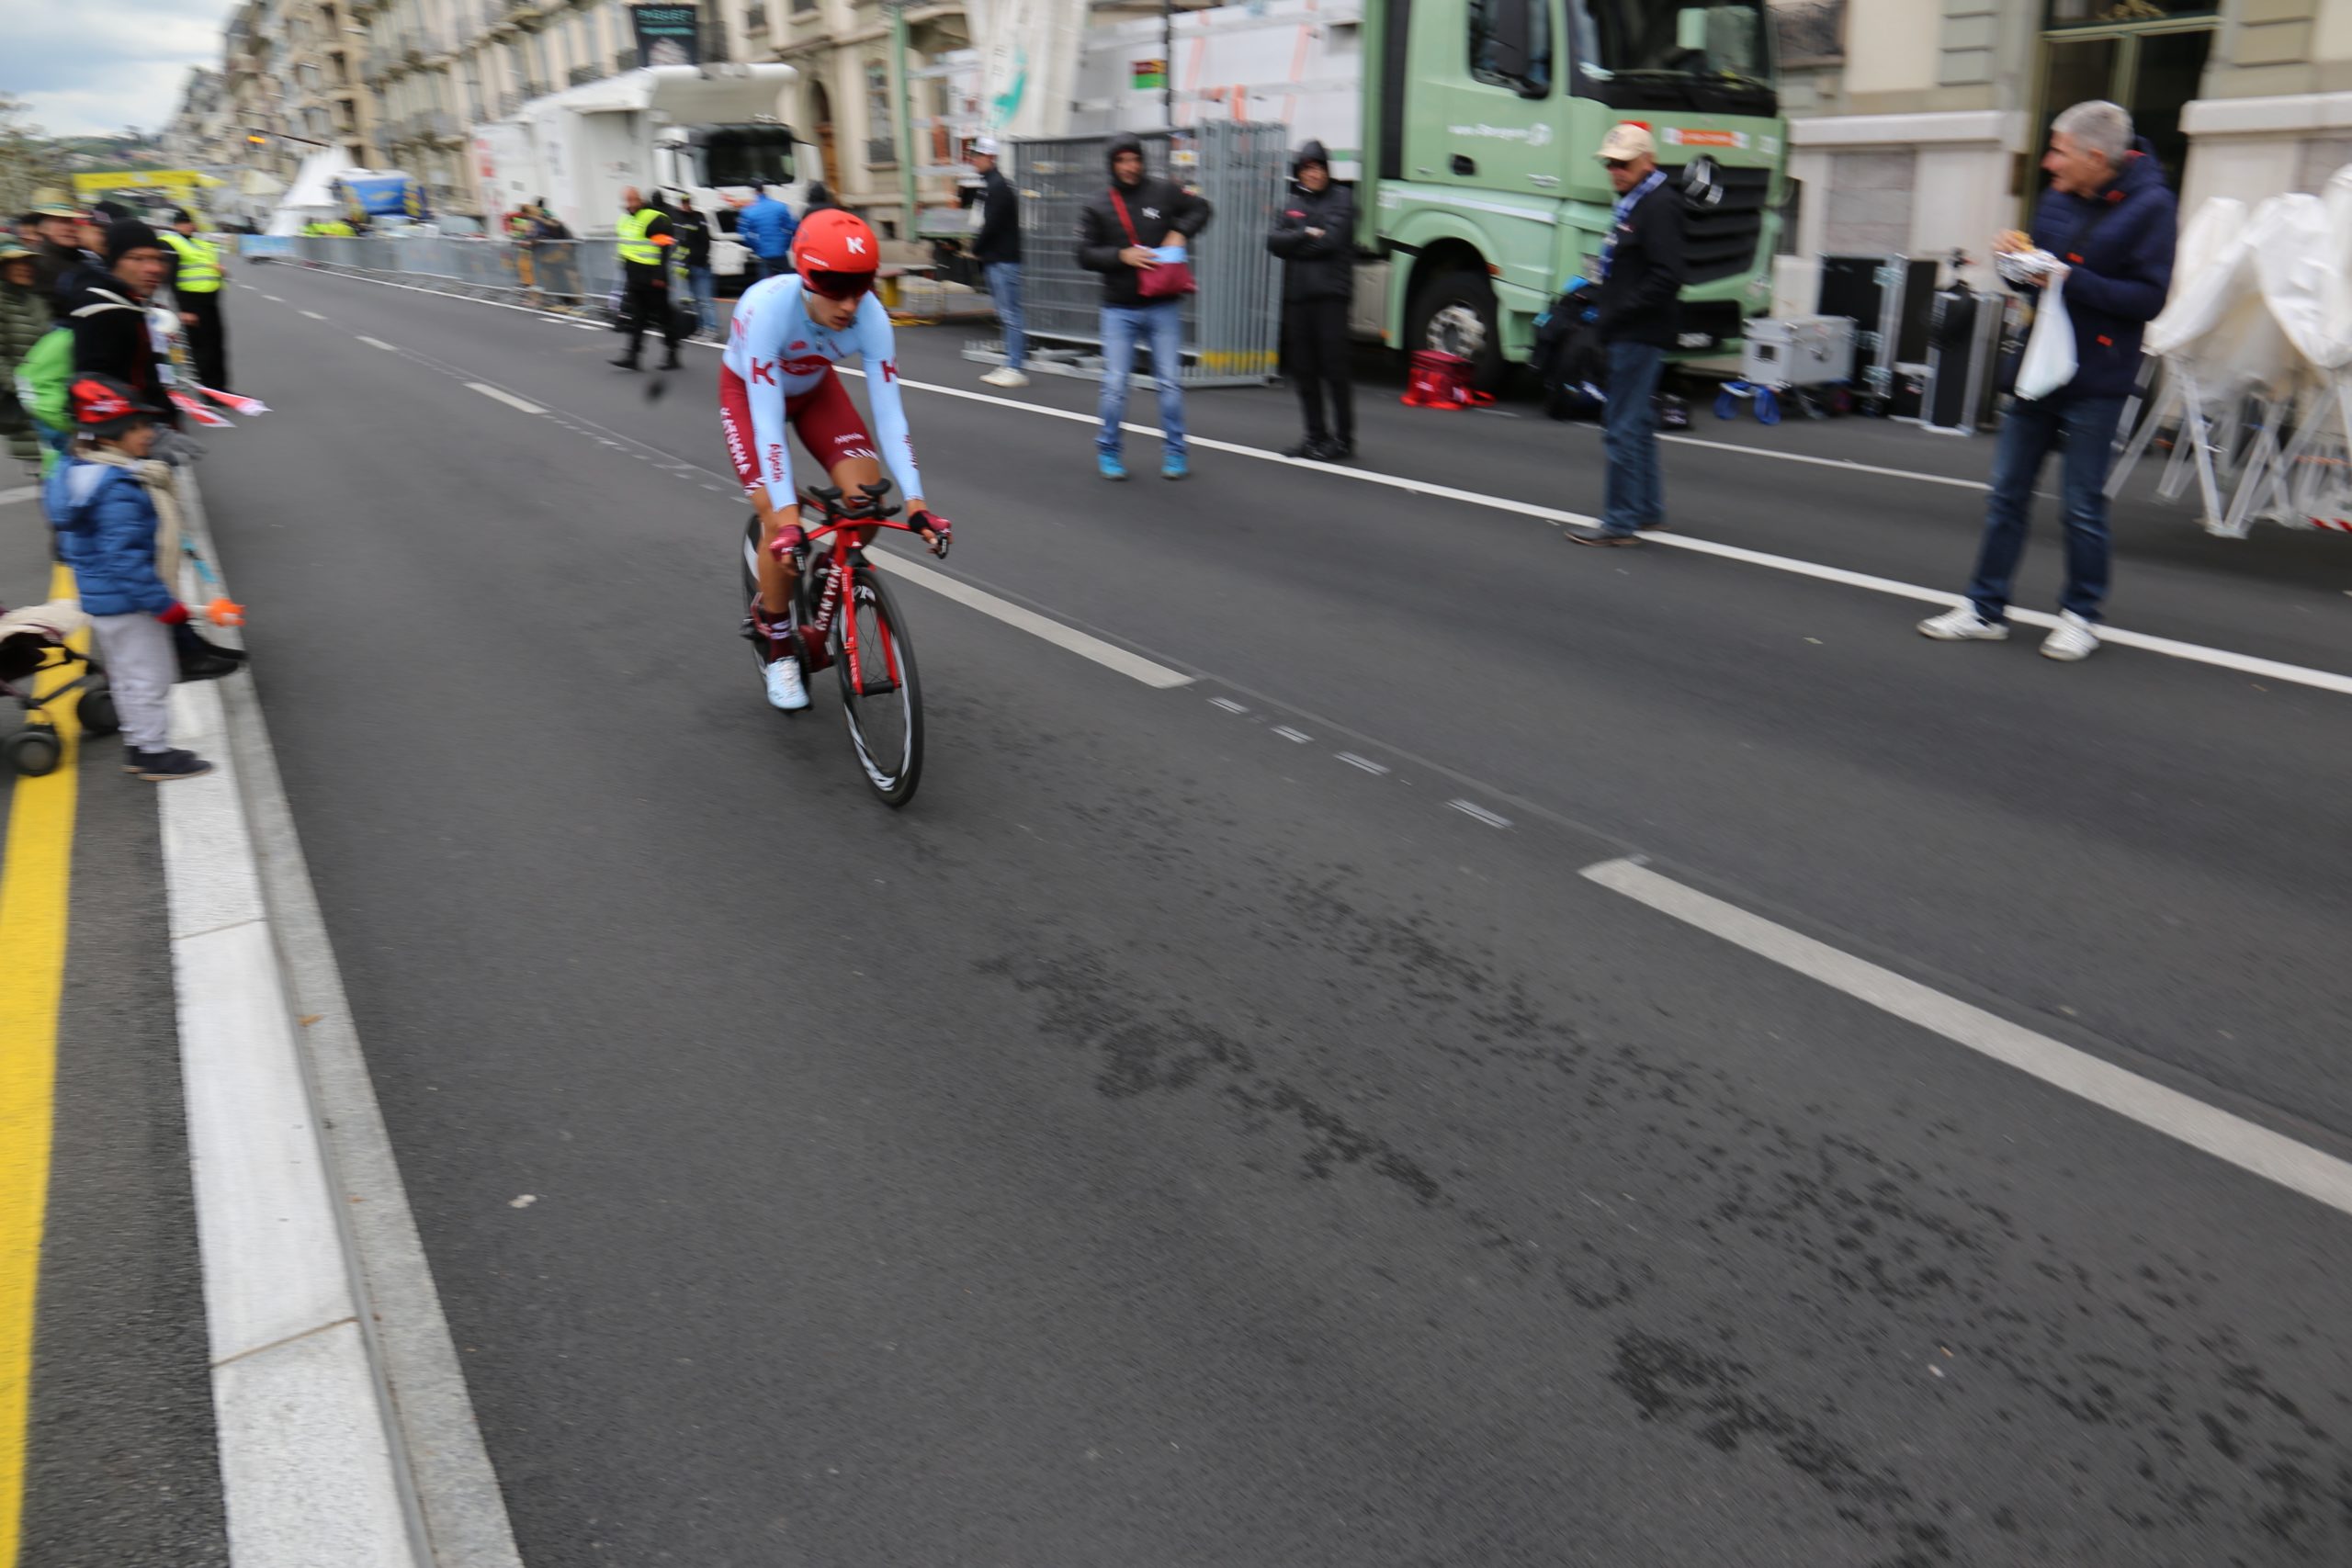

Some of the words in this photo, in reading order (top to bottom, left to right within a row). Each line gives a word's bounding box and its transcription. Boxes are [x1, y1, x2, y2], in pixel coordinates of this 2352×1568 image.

[845, 236, 866, 255] K
[751, 356, 776, 386] K
[814, 563, 842, 631] CANYON
